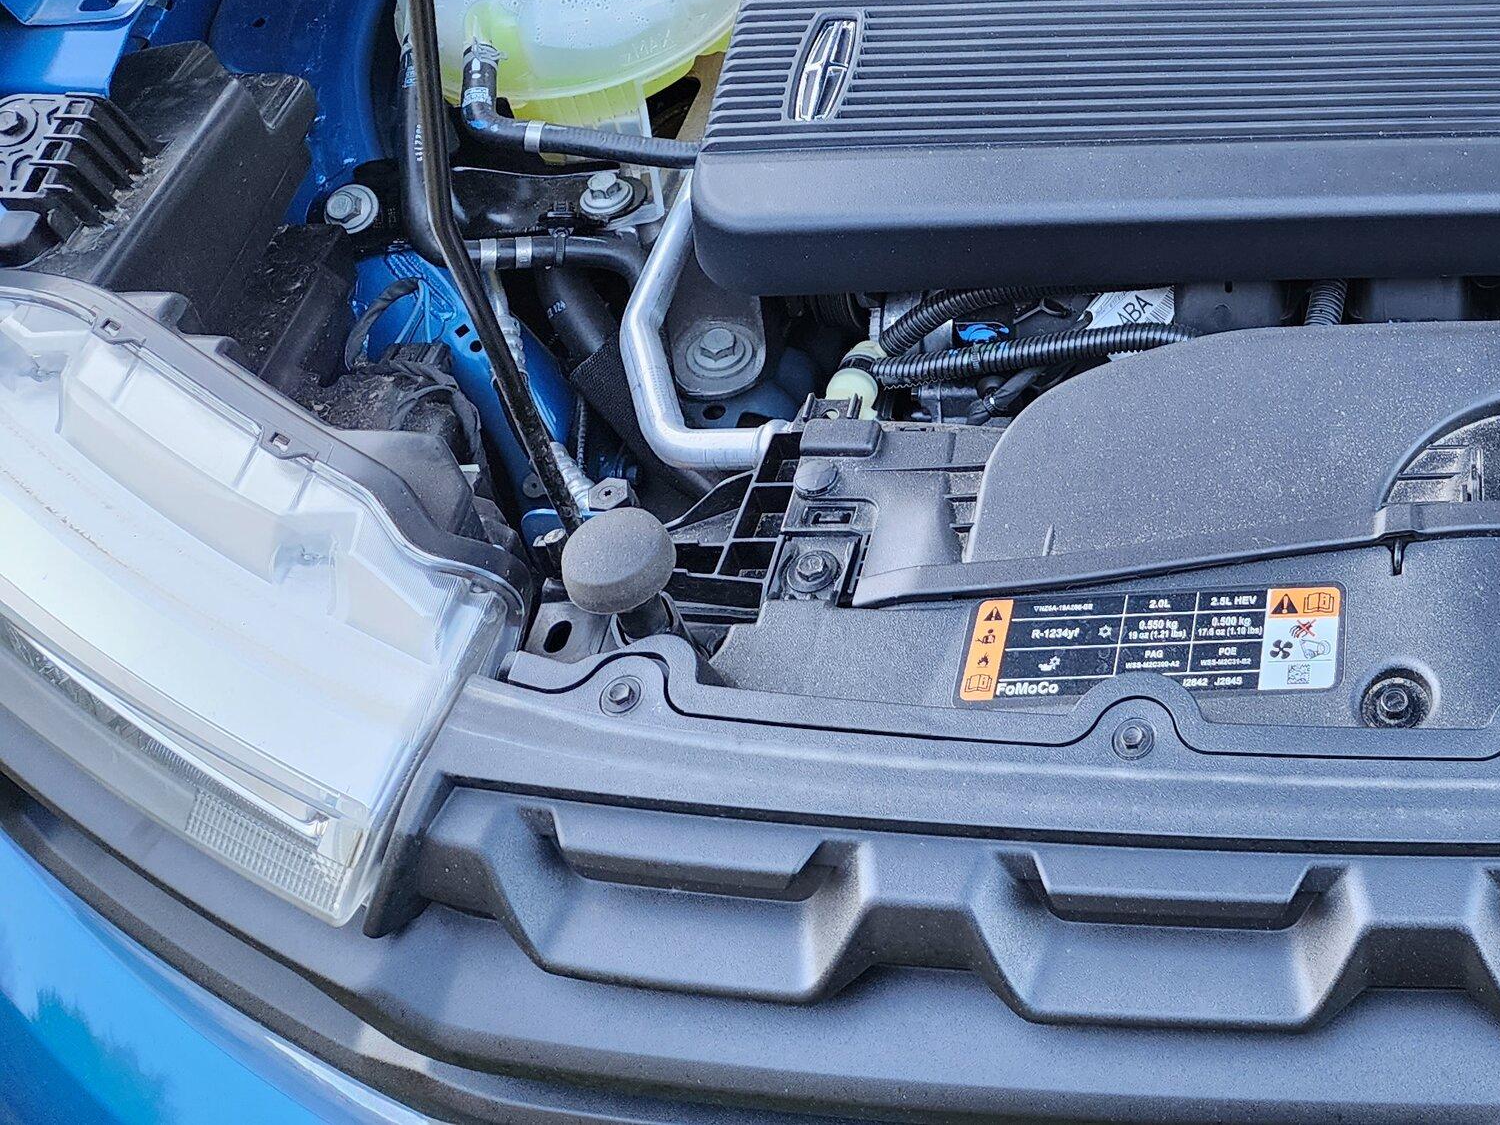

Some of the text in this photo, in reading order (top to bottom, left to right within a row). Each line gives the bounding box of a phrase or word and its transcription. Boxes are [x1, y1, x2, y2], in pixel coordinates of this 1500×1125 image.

[1117, 294, 1153, 325] ABA
[1149, 599, 1171, 609] 2.0L
[1210, 595, 1257, 606] 2.5L HEV
[1138, 619, 1179, 630] 0.550 kg
[1212, 616, 1252, 627] 0.500 kg
[1031, 627, 1080, 640] R-1234yf
[1170, 629, 1187, 639] lbs)
[1215, 628, 1226, 636] oz
[1247, 625, 1263, 636] lbs)
[1144, 649, 1164, 659] PAG
[1218, 647, 1238, 656] POE
[995, 681, 1059, 696] FoMoCo
